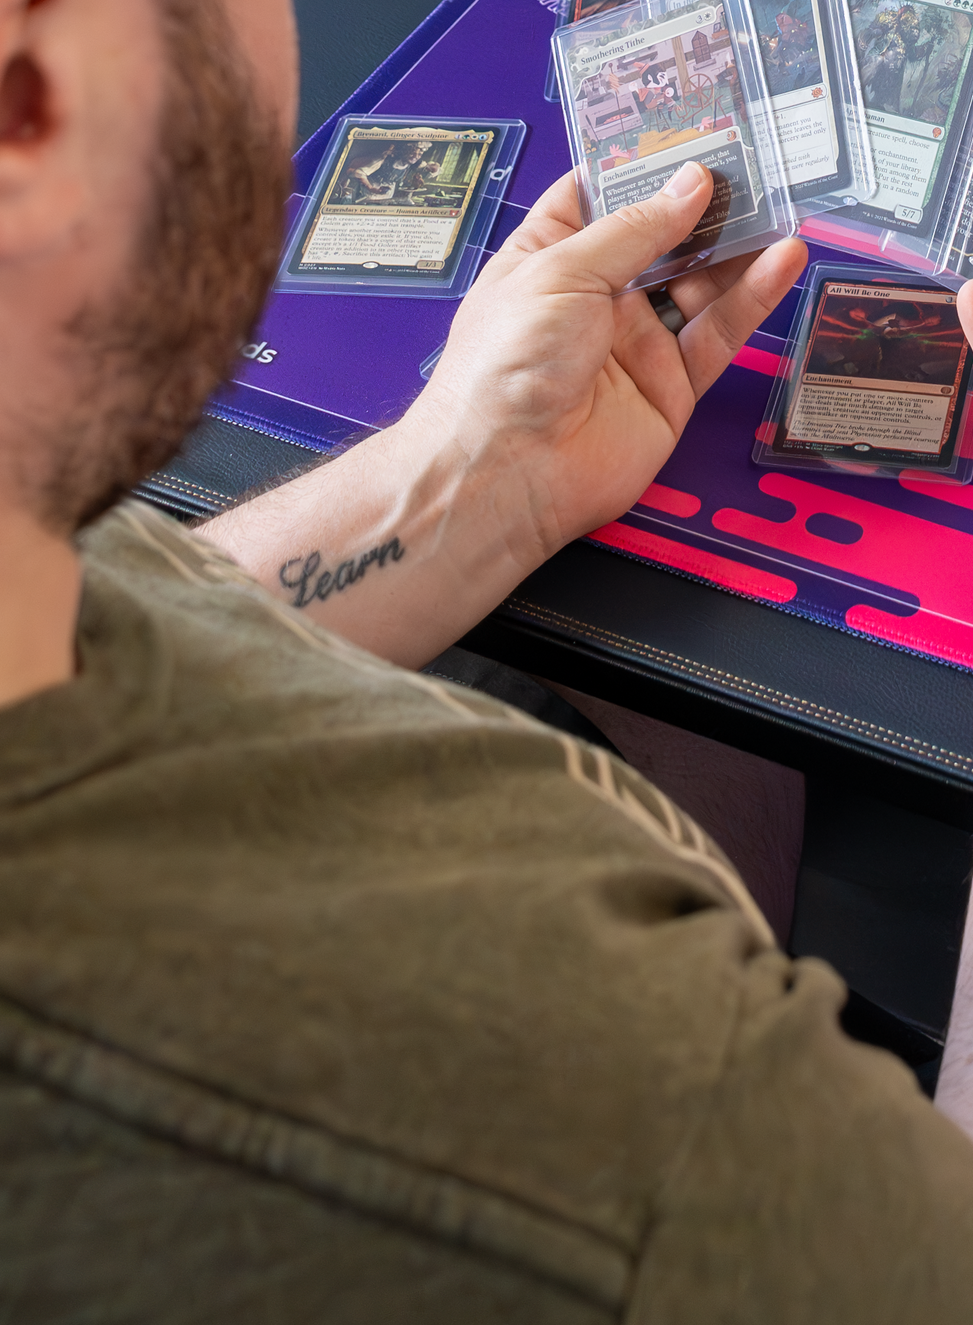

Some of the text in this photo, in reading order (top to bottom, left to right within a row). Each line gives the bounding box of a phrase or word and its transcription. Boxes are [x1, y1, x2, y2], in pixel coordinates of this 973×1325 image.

[580, 37, 645, 66] Smothering Tithe
[602, 164, 646, 183] Enchantment
[902, 209, 916, 218] 5/7
[829, 286, 842, 294] All
[844, 288, 860, 296] Will
[874, 290, 890, 298] One
[804, 374, 852, 386] Enchantment
[278, 536, 405, 609] Learn
